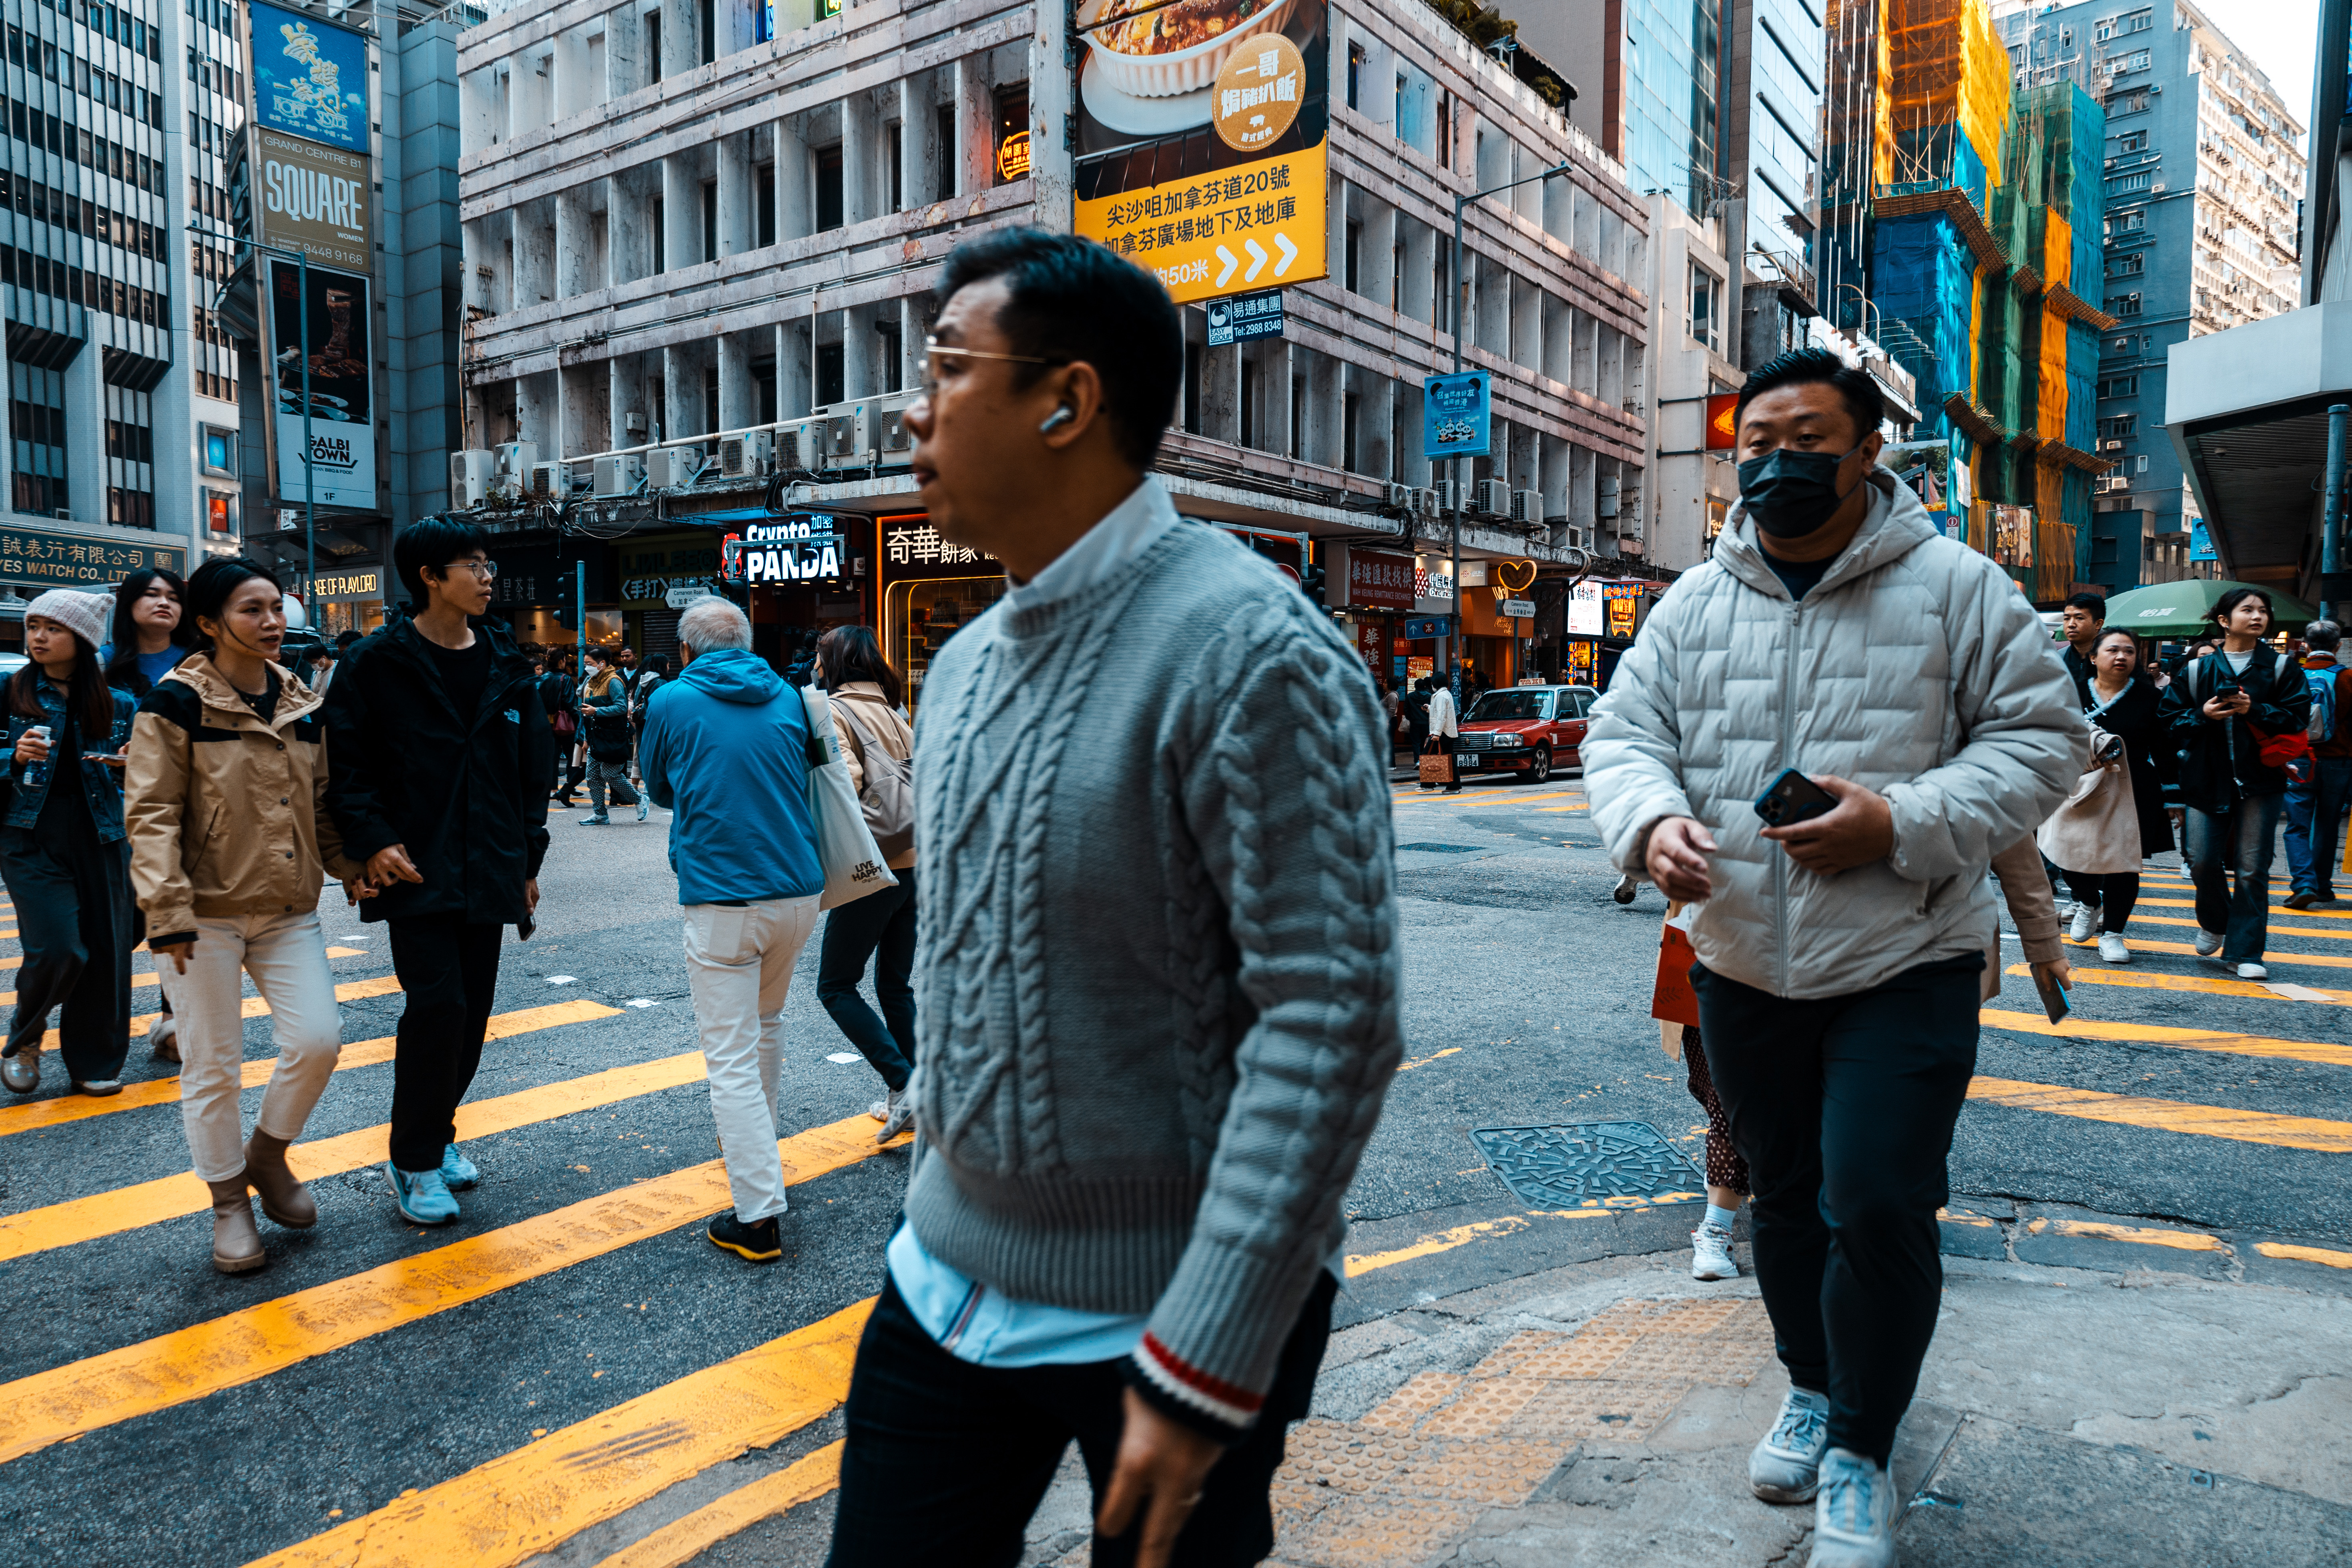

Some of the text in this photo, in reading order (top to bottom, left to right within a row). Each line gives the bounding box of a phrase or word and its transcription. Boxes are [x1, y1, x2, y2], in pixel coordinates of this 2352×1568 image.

[1236, 49, 1279, 77] 一哥
[1221, 70, 1296, 120] 焗豬扒飯
[1241, 126, 1273, 143] 港式經典
[265, 137, 361, 169] GRAND CENTRE B1
[266, 160, 363, 231] SQUARE
[1107, 164, 1290, 228] 尖沙咀加拿芬道20號
[1104, 196, 1296, 255] 加拿芬廣場地下及地庫
[337, 232, 364, 243] WOMEN
[303, 243, 332, 258] 9448
[335, 250, 363, 265] 9168
[1233, 295, 1280, 318] 易通集團
[1210, 327, 1225, 335] EASY
[1264, 319, 1281, 332] 8348
[1210, 333, 1232, 341] GROUP
[311, 435, 349, 451] GALBI
[324, 492, 335, 500] 1F
[811, 515, 833, 530] 加密
[747, 521, 811, 549] Crypto
[887, 525, 978, 564] 奇華餅家
[0, 536, 143, 568] 誠表行有限公司
[27, 562, 75, 578] WATCH
[78, 567, 104, 582] CO.,
[747, 546, 839, 581] PANDA
[327, 578, 337, 595] OF
[338, 574, 376, 594] PLAYLORD
[1352, 560, 1412, 590] 華強匯款找換
[1352, 588, 1411, 601] WAH KEUNG REMITTANCE EXCHANGE
[1364, 628, 1380, 666] 華強
[851, 864, 882, 882] HAPPY
[855, 860, 874, 873] LIVE
